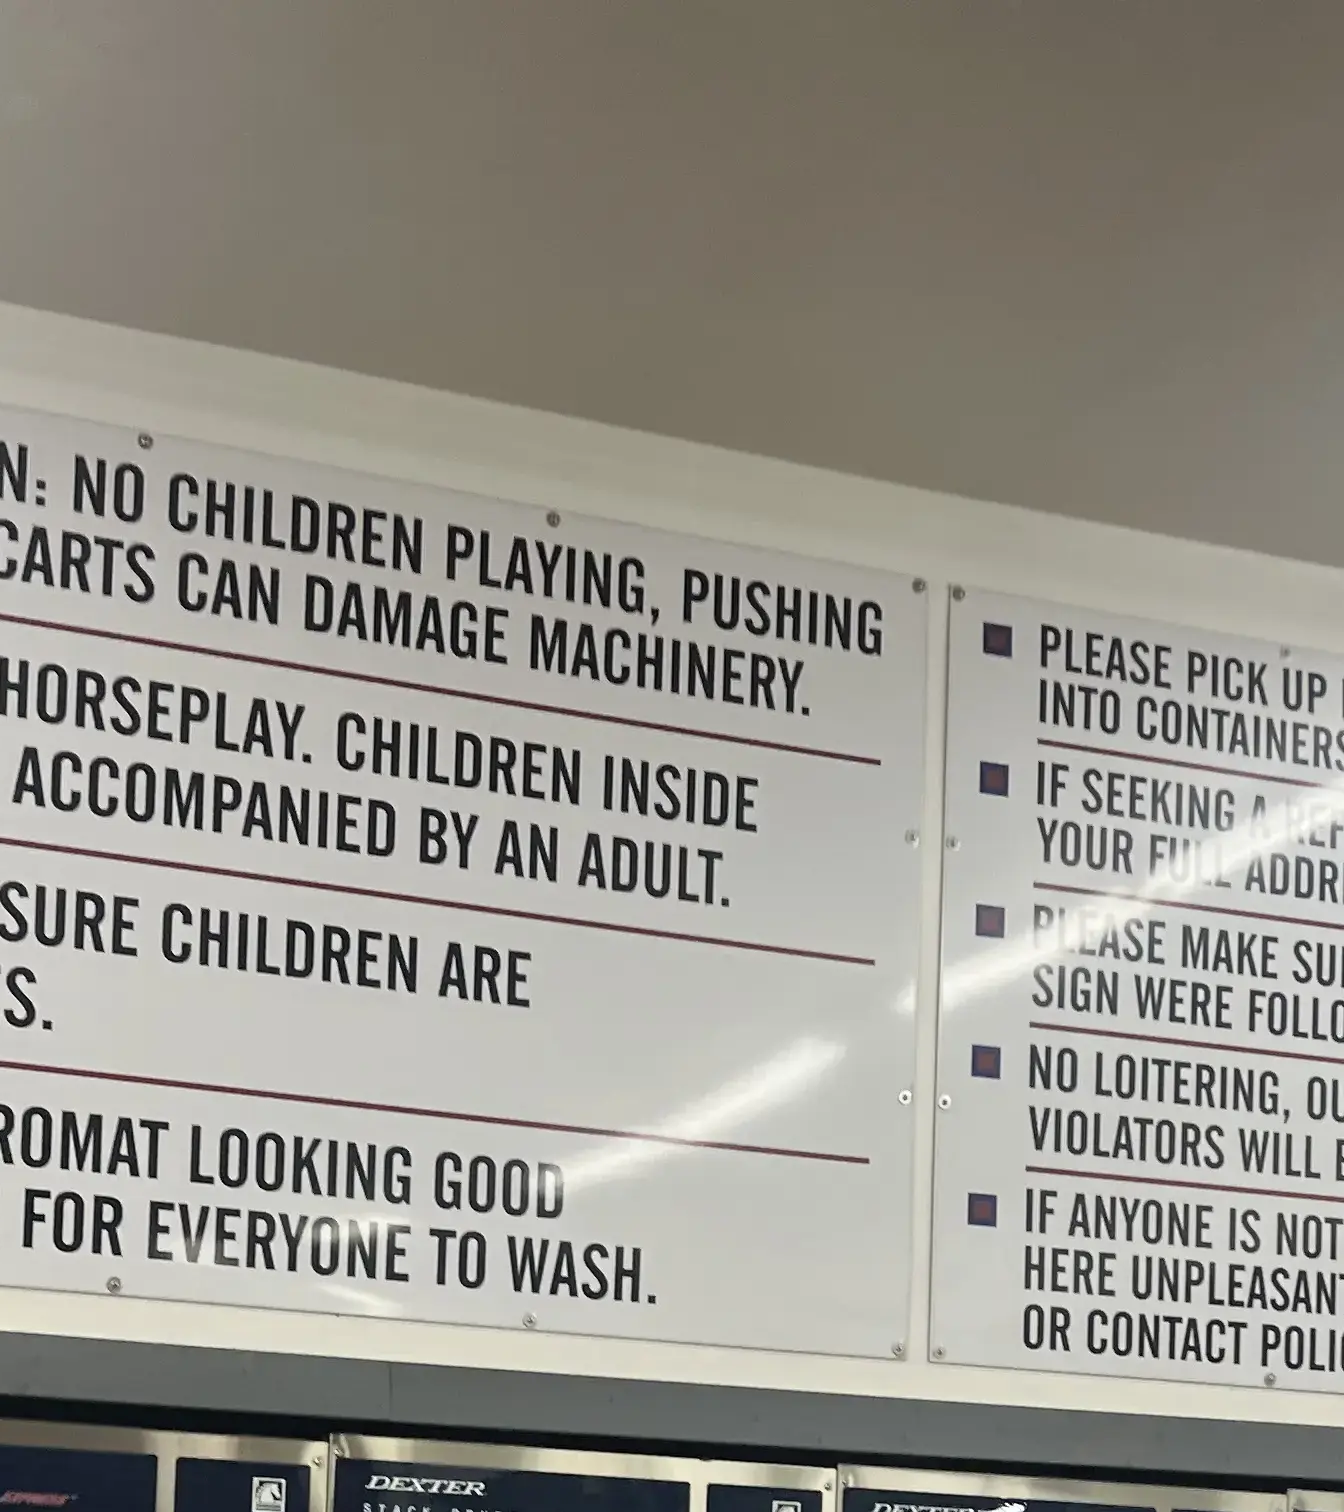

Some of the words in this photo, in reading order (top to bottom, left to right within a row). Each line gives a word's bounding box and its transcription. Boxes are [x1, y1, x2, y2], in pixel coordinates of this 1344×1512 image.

[72, 453, 145, 524] NO
[167, 472, 423, 575] CHILDREN
[445, 523, 660, 627] PLAYING,
[682, 568, 883, 657] PUSHING
[177, 551, 281, 627] CAN
[303, 573, 510, 666] DAMAGE
[529, 613, 810, 717] MACHINERY.
[1040, 623, 1173, 690] PLEASE
[1187, 649, 1269, 707] PICK
[1282, 666, 1328, 716] UP
[1039, 679, 1121, 736] INTO
[336, 711, 582, 806] CHILDREN
[603, 754, 759, 834] INSIDE
[1036, 760, 1070, 808] IF
[1081, 767, 1236, 832] SEEKING
[11, 745, 397, 858] ACCOMPANIED
[418, 805, 480, 870] BY
[494, 818, 559, 884] AN
[577, 831, 730, 908] ADULT.
[1036, 816, 1134, 875] YOUR
[161, 902, 419, 994] CHILDREN
[437, 941, 532, 1009] ARE
[1180, 923, 1279, 981] MAKE
[1031, 964, 1119, 1017] SIGN
[1133, 973, 1234, 1030] WERE
[1028, 1043, 1079, 1094] NO
[1094, 1051, 1291, 1125] LOITERING,
[189, 1123, 413, 1206] LOOKING
[433, 1151, 565, 1220] GOOD
[1028, 1105, 1226, 1170] VIOLATORS
[1237, 1127, 1322, 1180] WILL
[21, 1187, 124, 1258] FOR
[146, 1199, 412, 1283] EVERYONE
[428, 1227, 487, 1290] TO
[506, 1234, 657, 1305] WASH.
[1025, 1187, 1058, 1235] IF
[1067, 1192, 1214, 1250] ANYONE
[1228, 1207, 1262, 1255] IS
[1275, 1211, 1344, 1261] NOT
[1023, 1244, 1117, 1298] HERE
[1022, 1303, 1072, 1352] OR
[1086, 1308, 1249, 1366] CONTACT
[364, 1474, 486, 1497] DEXTER
